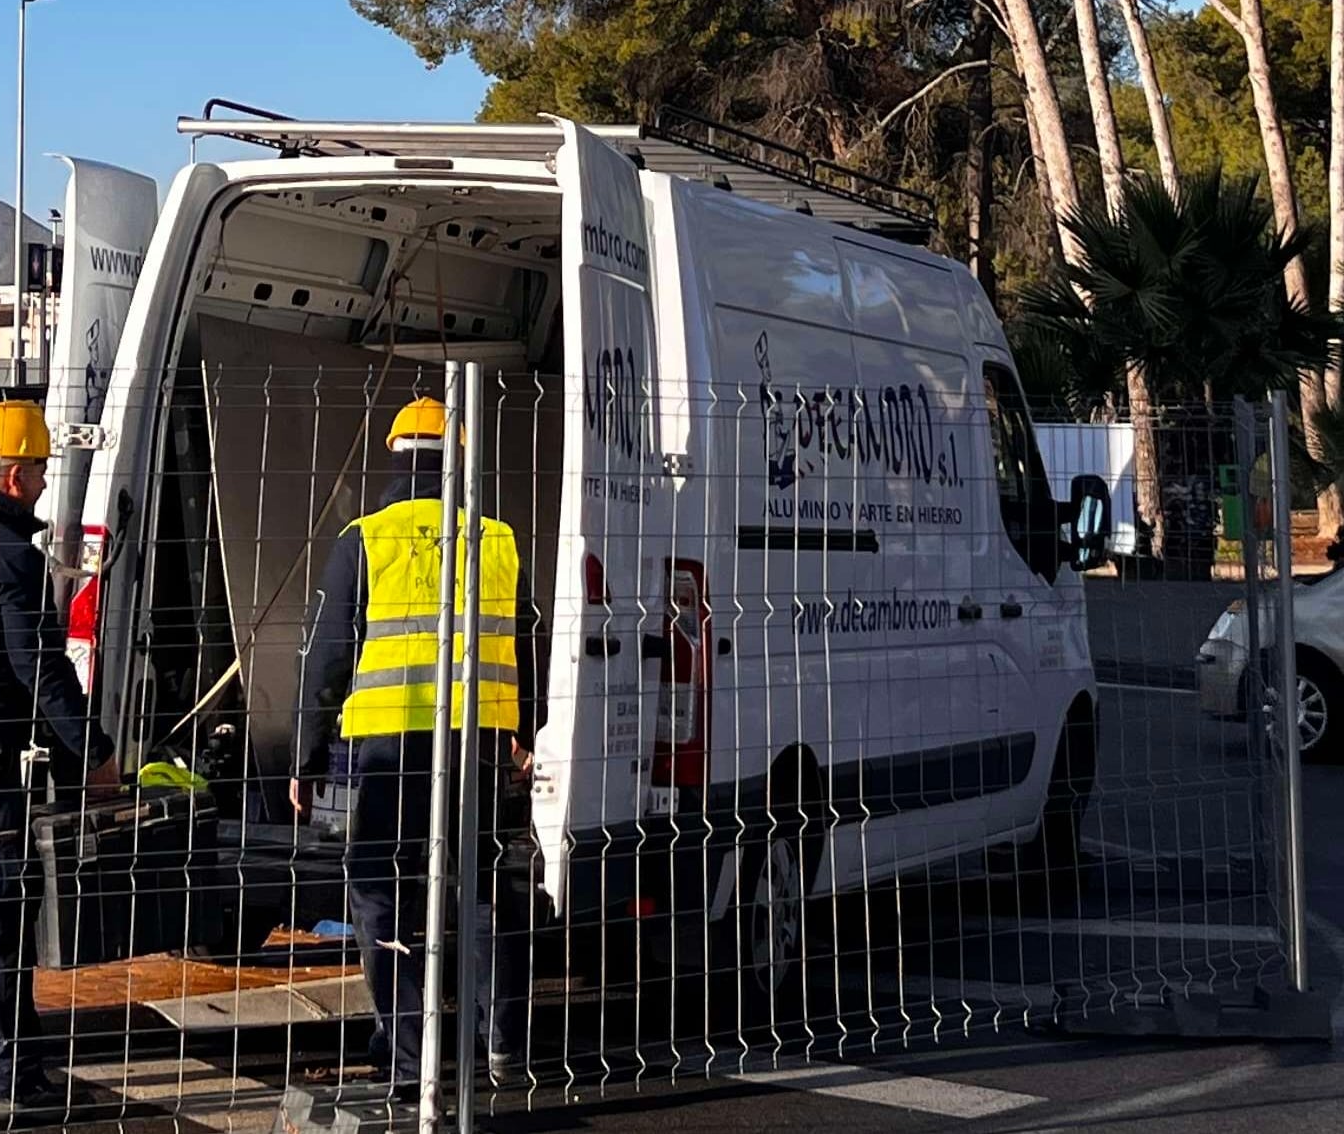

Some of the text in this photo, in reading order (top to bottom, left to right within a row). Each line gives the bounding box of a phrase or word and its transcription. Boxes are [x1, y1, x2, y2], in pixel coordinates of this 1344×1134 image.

[763, 498, 841, 520] ALUMINIO
[859, 503, 892, 522] ARTE
[897, 505, 914, 522] EN
[918, 506, 962, 524] HIERRO
[791, 587, 951, 634] www.decambro.com
